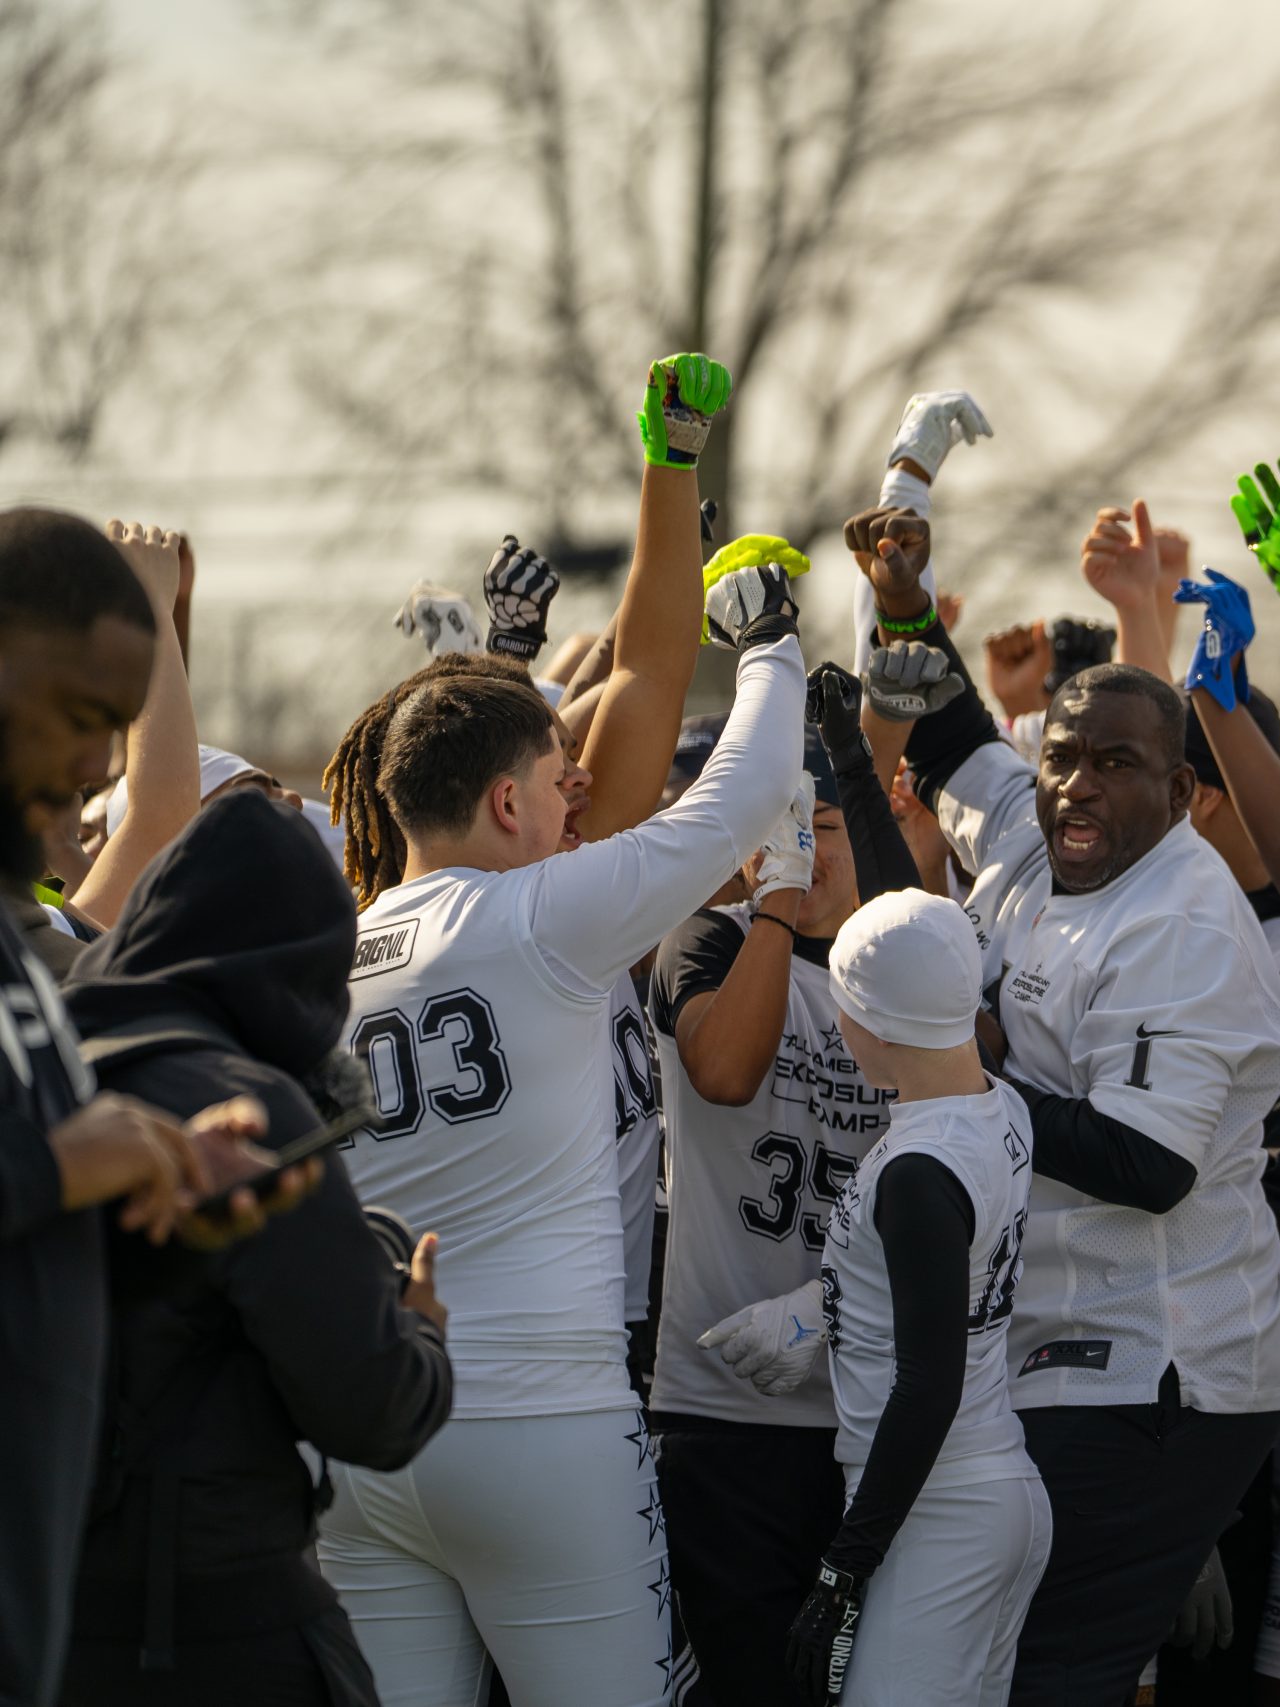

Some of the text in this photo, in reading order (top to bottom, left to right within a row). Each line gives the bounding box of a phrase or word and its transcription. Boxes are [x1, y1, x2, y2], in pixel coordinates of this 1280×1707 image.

[352, 929, 409, 970] BIGNIL
[1012, 978, 1046, 998] EXPOSURE
[335, 987, 512, 1150] 03
[1123, 1040, 1153, 1092] 1
[827, 1636, 854, 1694] NXTRND
